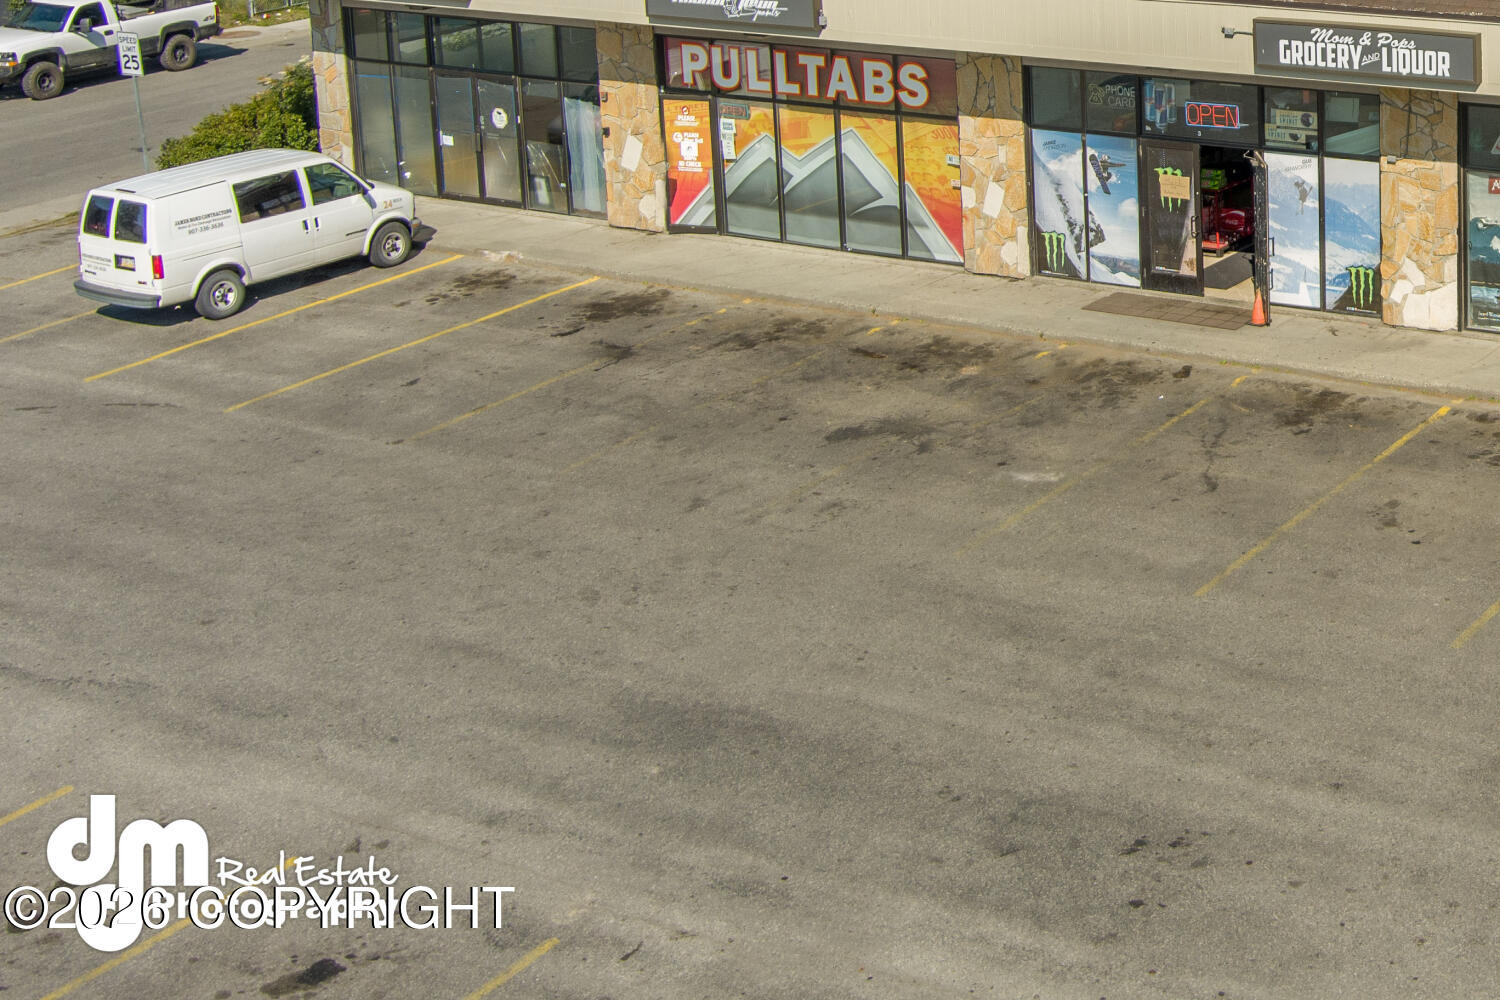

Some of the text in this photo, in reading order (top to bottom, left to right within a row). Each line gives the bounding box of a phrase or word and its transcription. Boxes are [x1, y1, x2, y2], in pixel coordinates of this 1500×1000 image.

[119, 36, 137, 45] SPEED
[1310, 28, 1416, 50] Mom & Pops
[121, 45, 136, 53] LIMIT
[122, 54, 140, 70] 25
[1279, 39, 1450, 77] GROCERY AND LIQUOR
[680, 41, 930, 109] PULLTABS
[1105, 84, 1136, 98] PHONE
[1107, 96, 1136, 108] CARD
[1187, 103, 1239, 129] OPEN
